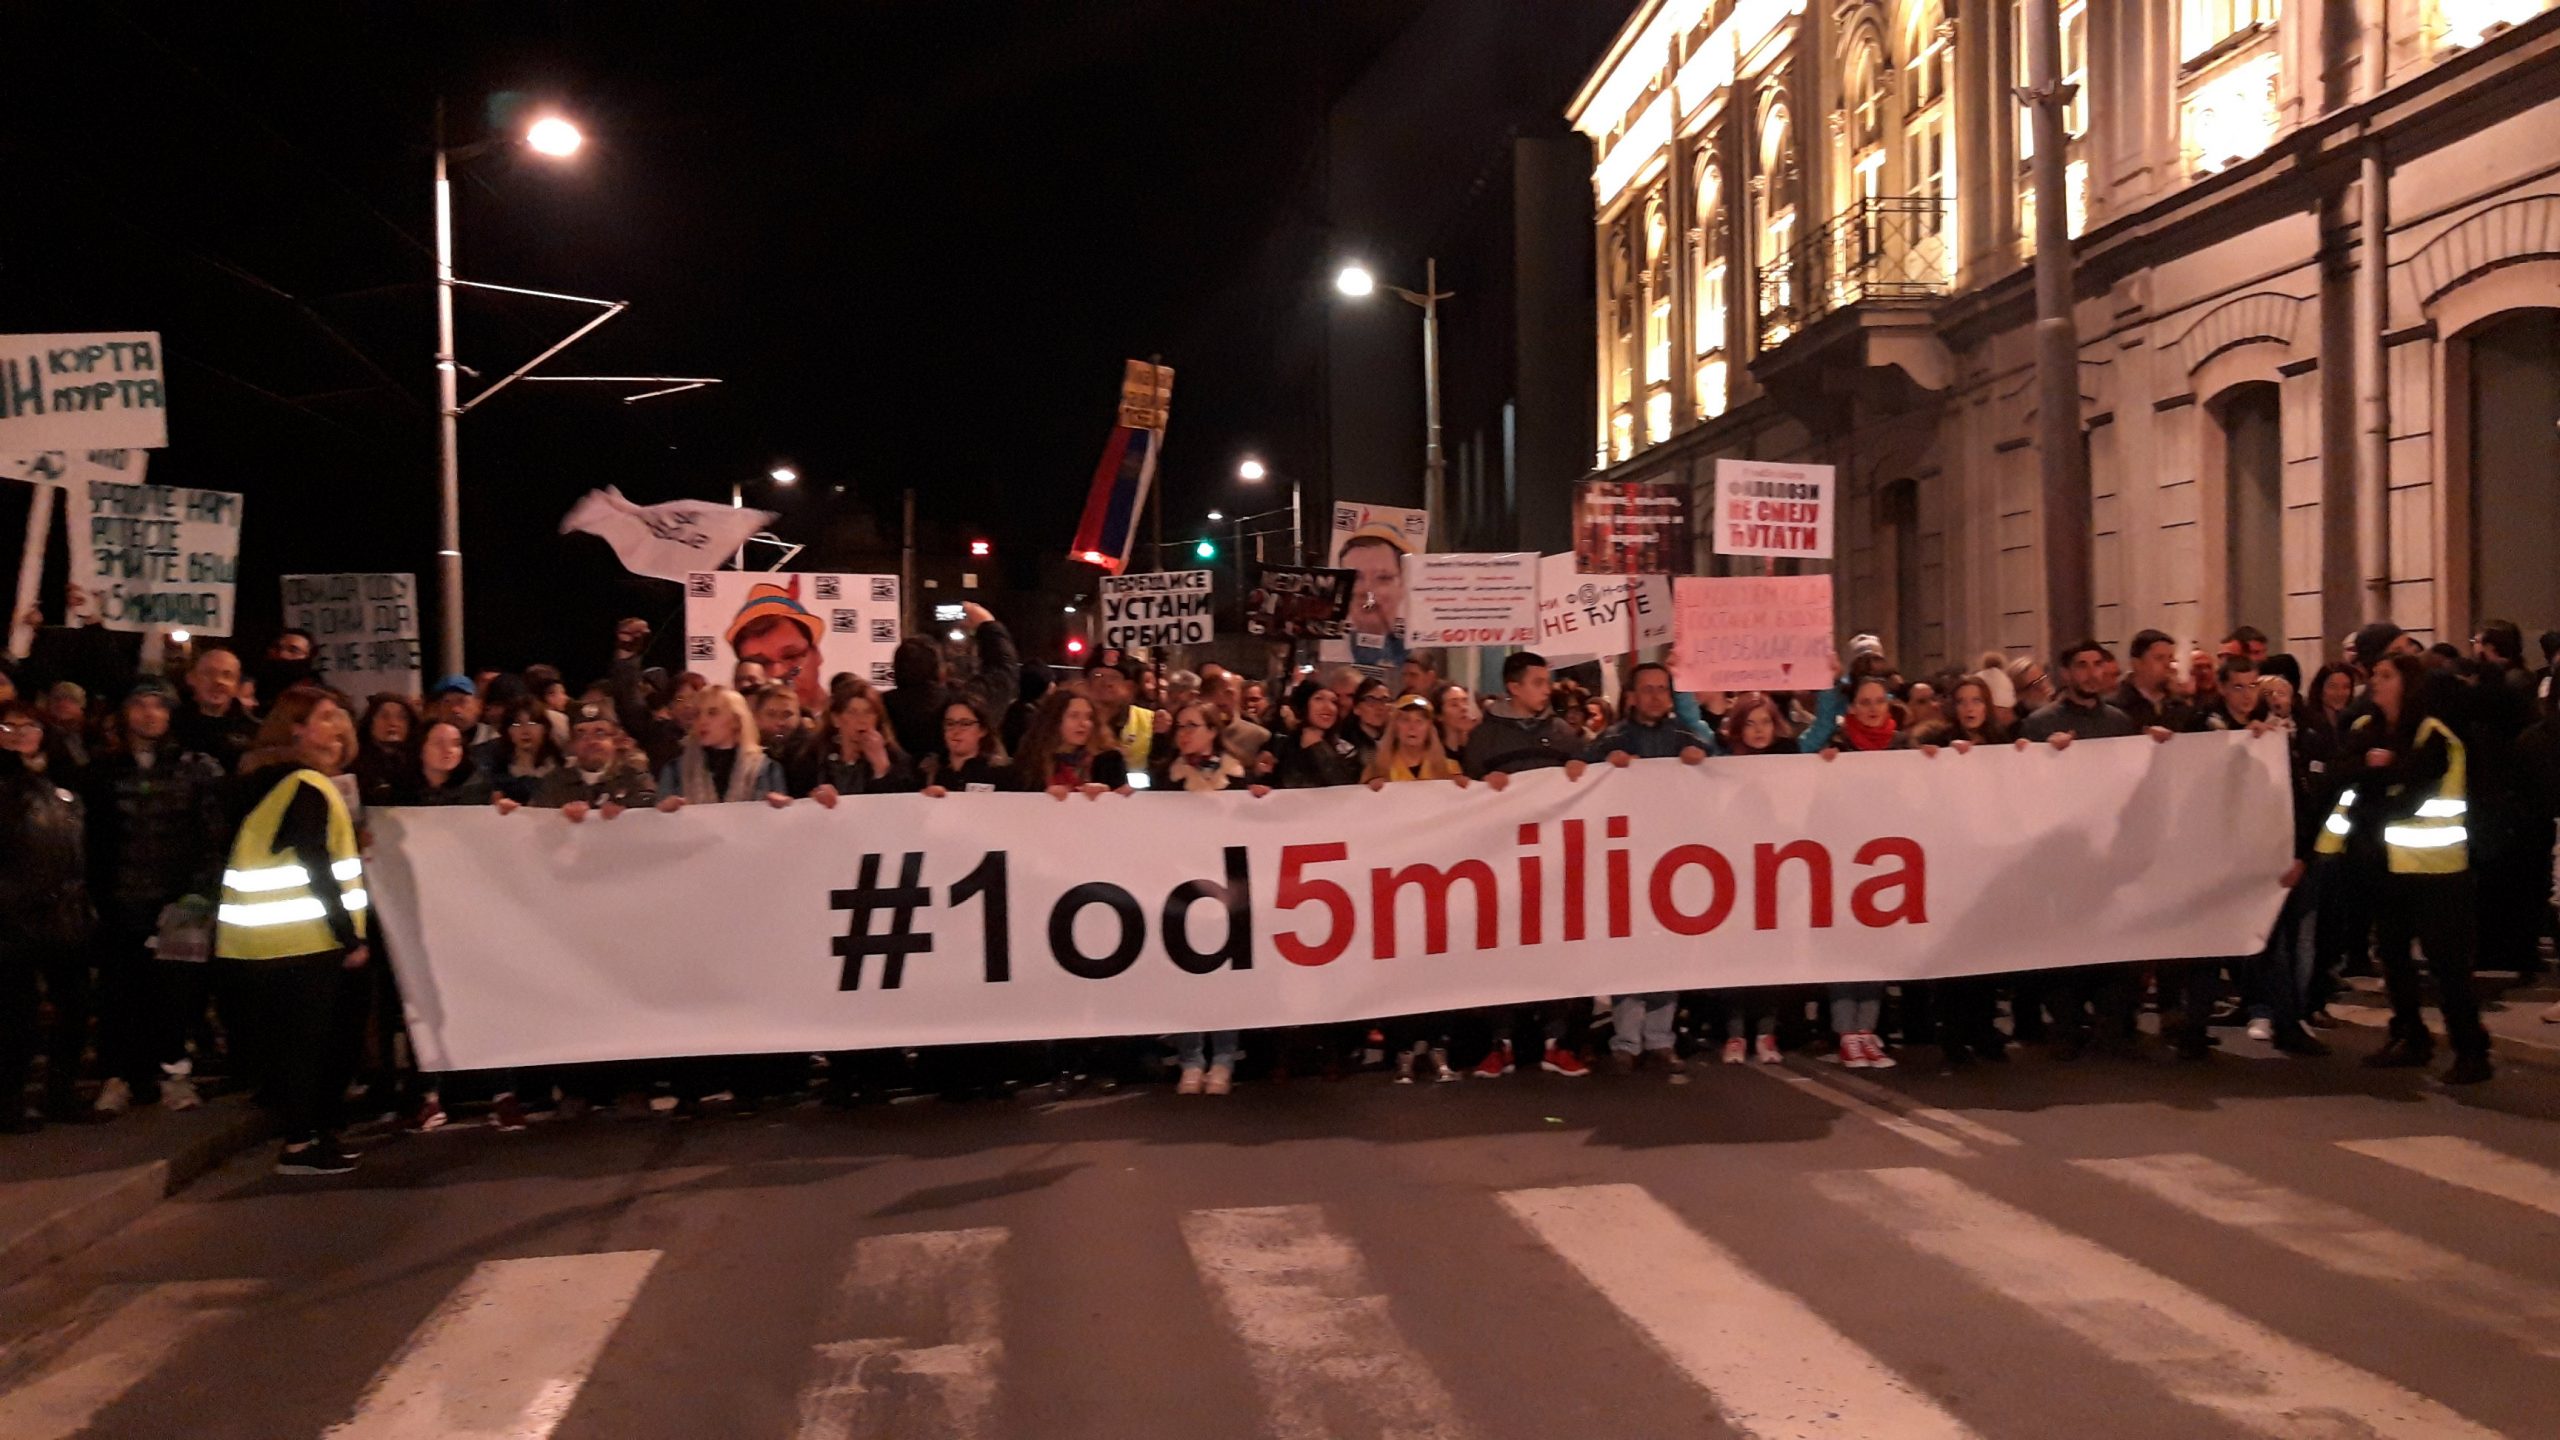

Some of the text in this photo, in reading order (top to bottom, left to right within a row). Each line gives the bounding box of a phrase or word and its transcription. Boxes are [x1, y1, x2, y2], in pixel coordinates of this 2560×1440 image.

[1728, 500, 1819, 523] НЕ СМЕЈУ
[1728, 523, 1817, 550] ЋУТАТИ
[1105, 593, 1211, 621] УСТАНИ
[1543, 612, 1579, 637] НЕ
[1584, 594, 1652, 626] ЋУТЕ
[1107, 619, 1203, 648] СРБИЈО
[1442, 628, 1505, 642] GOTOV
[828, 815, 1929, 991] #1od5miliona
